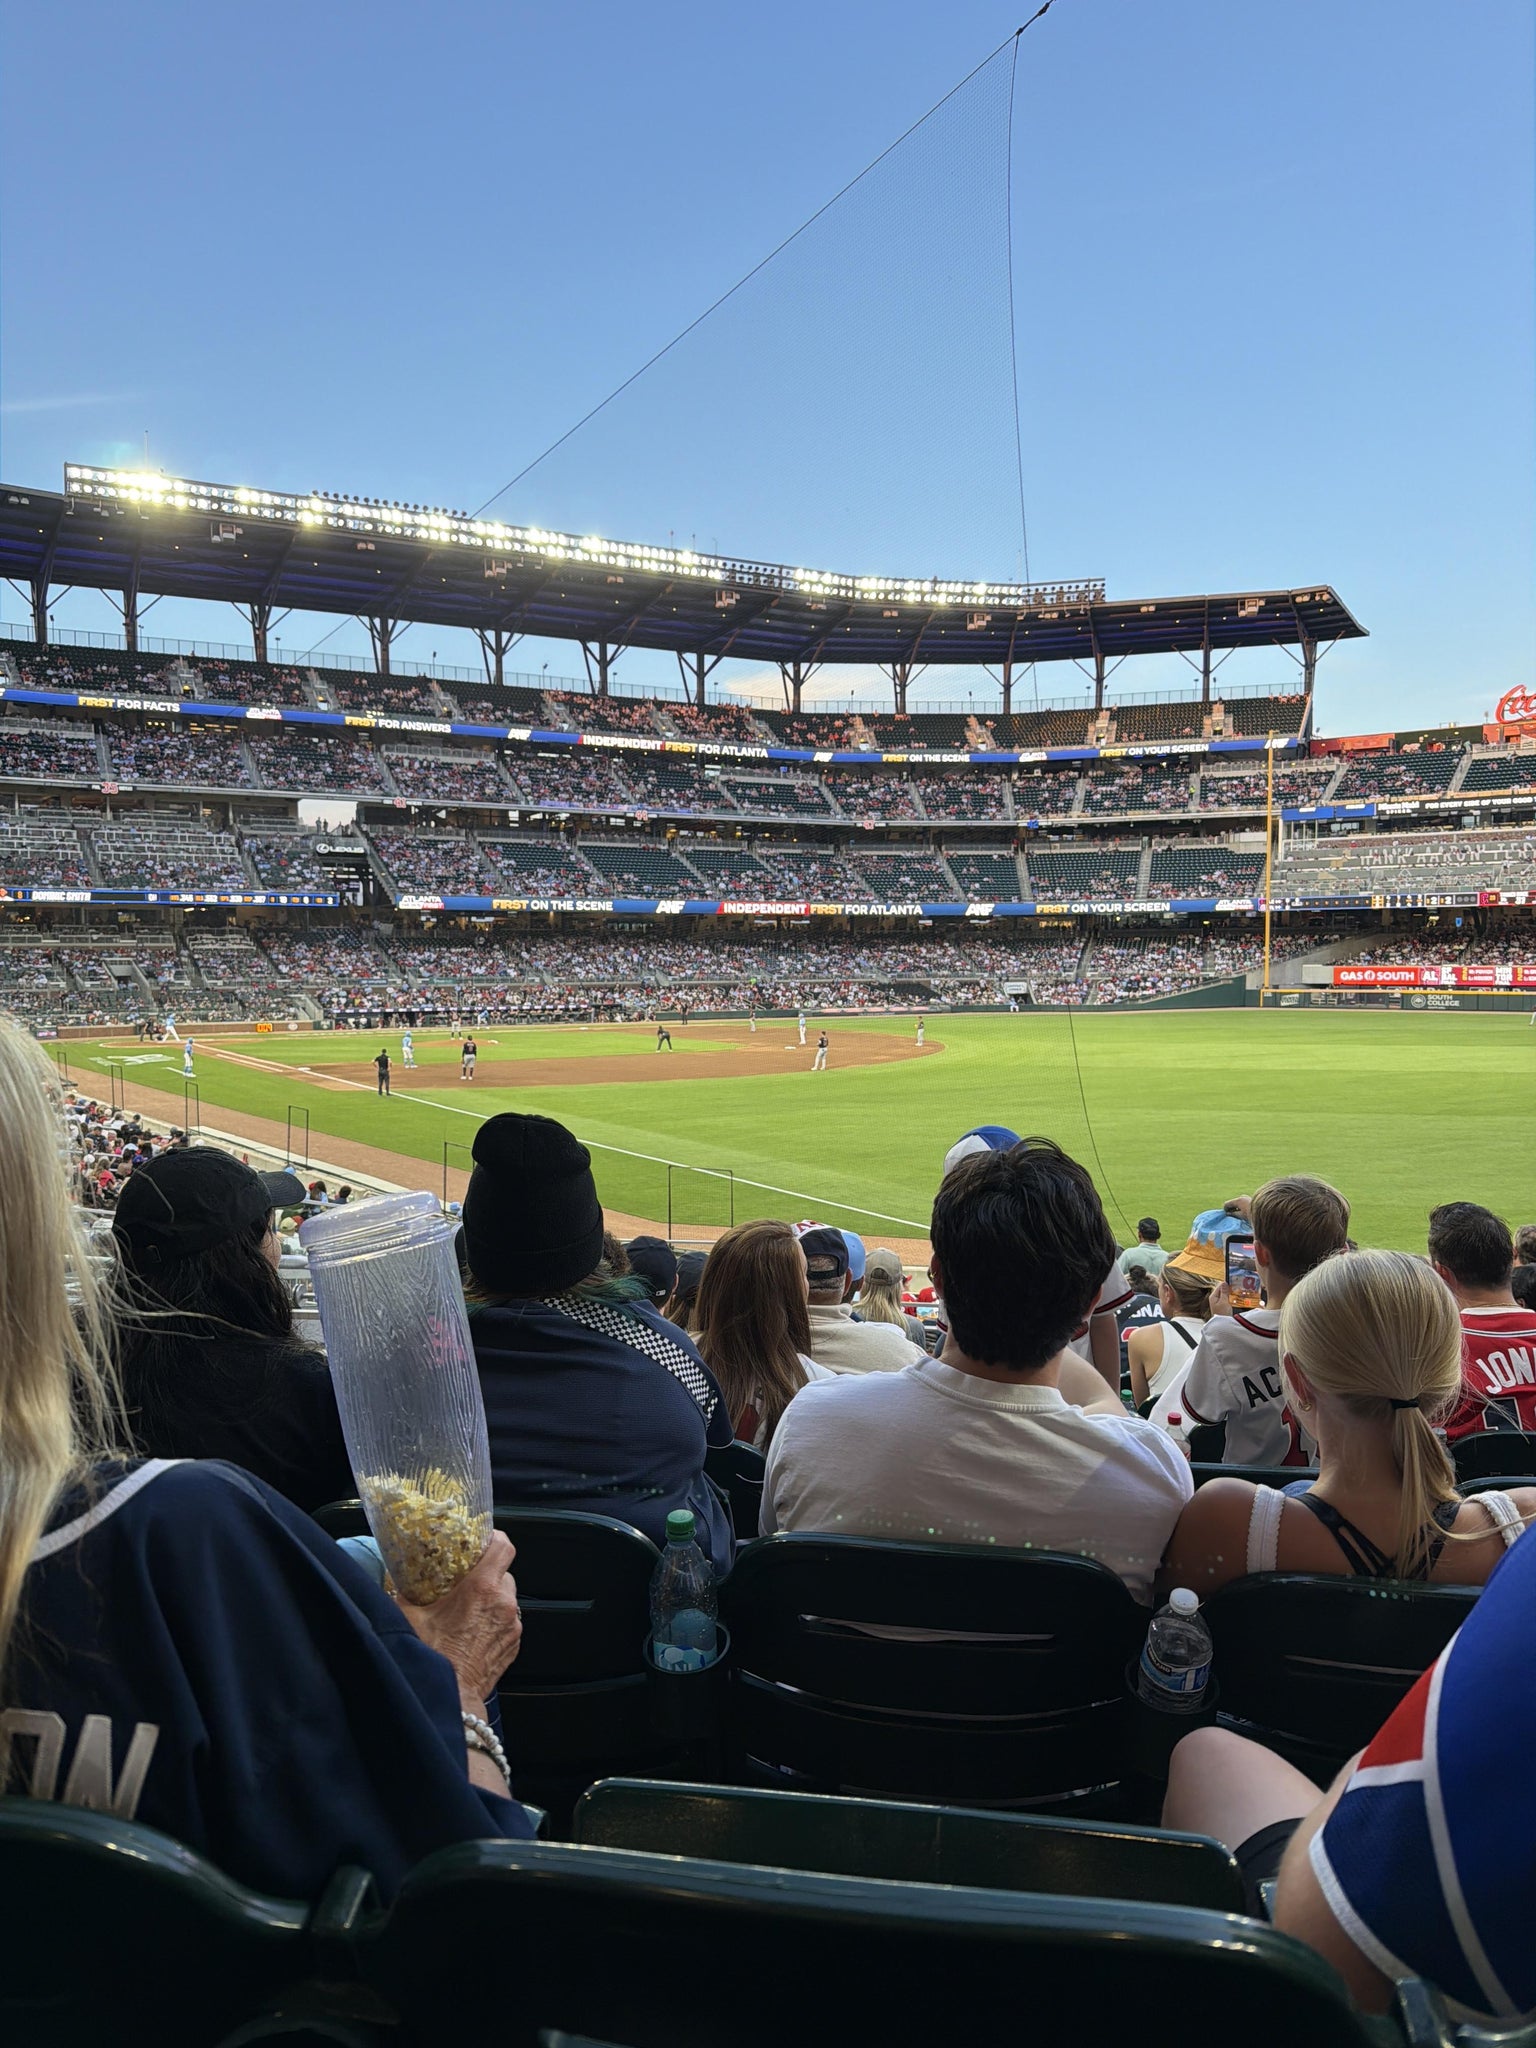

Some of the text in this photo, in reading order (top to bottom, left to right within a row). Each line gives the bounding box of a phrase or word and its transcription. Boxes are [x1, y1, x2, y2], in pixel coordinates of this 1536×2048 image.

[78, 697, 180, 712] FIRST FOR FACTS
[344, 715, 451, 733] FIRST FOR ANSWERS
[583, 734, 769, 758] INDEPENDENT FIRST FOR ATLANTA
[1099, 743, 1209, 758] FIRST ON YOUR SCREEN
[883, 753, 970, 762] FIRST ON THE SCENE
[492, 899, 613, 911] FIRST ON THE SCENE
[723, 902, 922, 916] INDEPENDENT FIRST FOR ATLANTA
[1036, 901, 1170, 914] FIRST ON YOUR SCREEN
[1340, 971, 1416, 981] GAS SOUTH
[1422, 971, 1439, 981] AL
[1475, 1347, 1536, 1394] JON
